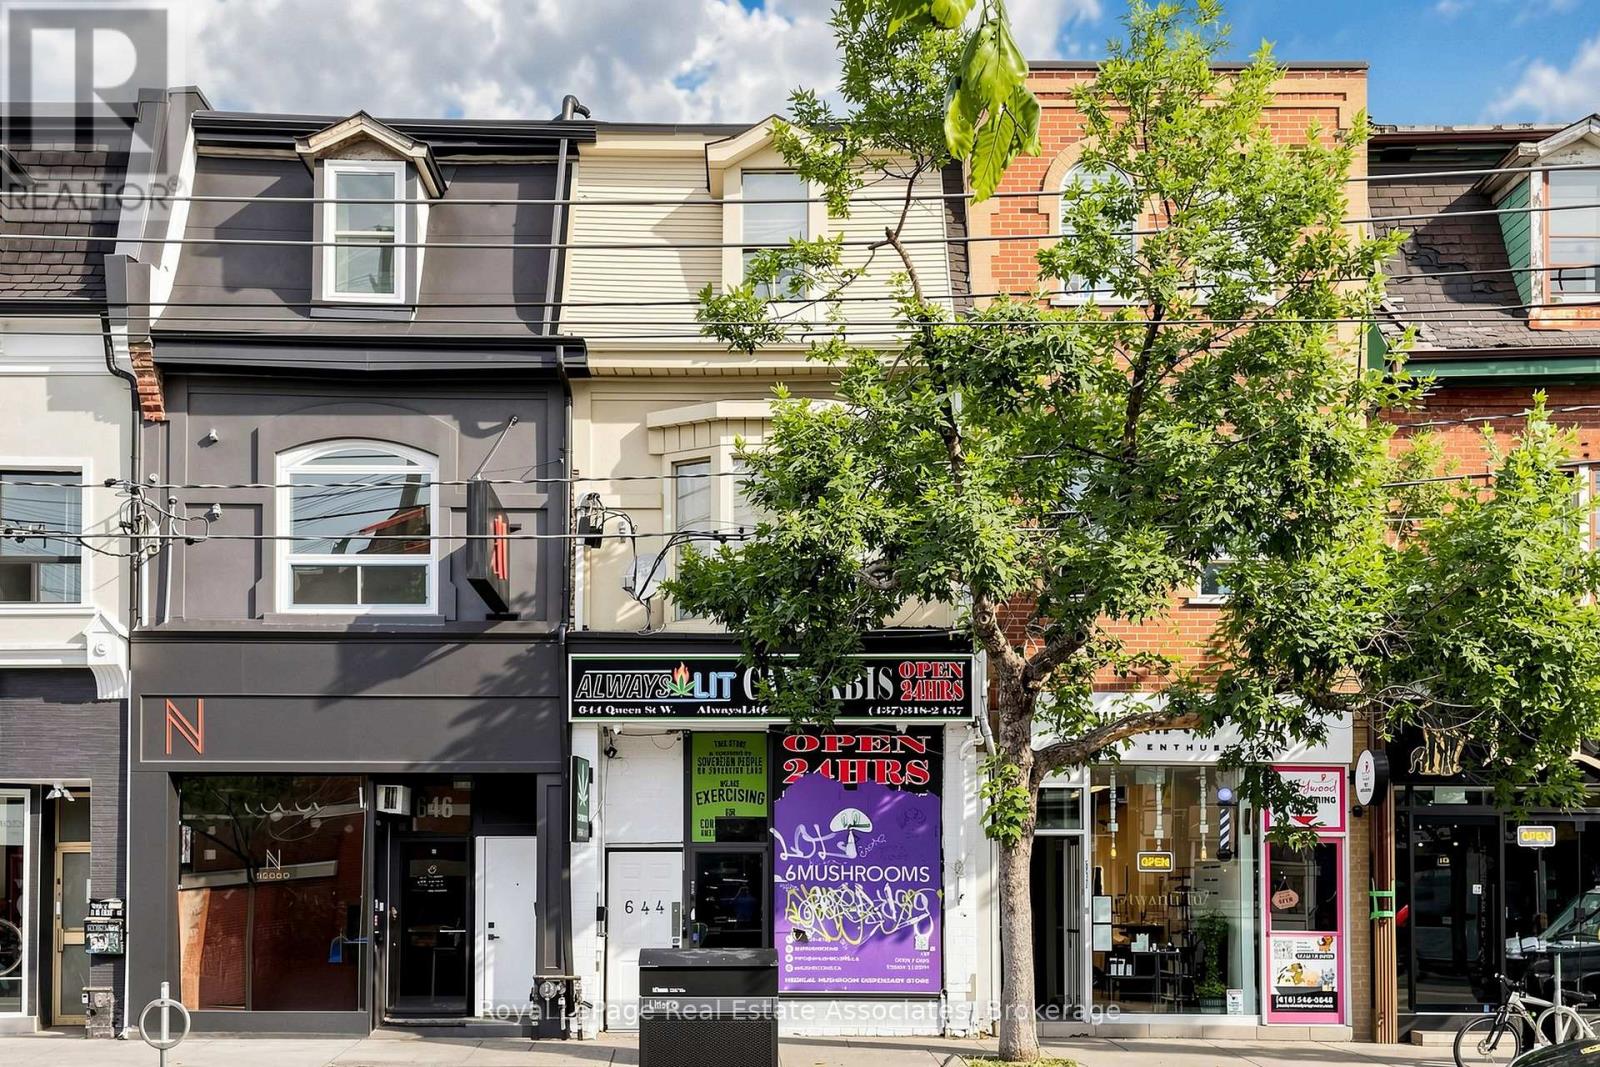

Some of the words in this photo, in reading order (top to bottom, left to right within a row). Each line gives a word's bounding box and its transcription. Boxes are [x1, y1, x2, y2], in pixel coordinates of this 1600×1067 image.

[898, 661, 966, 679] OPEN
[575, 673, 672, 699] ALWAYS
[693, 671, 737, 699] LIT
[900, 679, 965, 701] 24HRS
[605, 705, 642, 715] Queen
[645, 705, 657, 715] St
[660, 705, 676, 715] W.
[165, 698, 205, 755] N
[782, 734, 931, 754] OPEN
[697, 756, 736, 767] SOVEREIGN
[738, 756, 763, 767] PEOPLE
[782, 758, 931, 785] 24HRS
[695, 788, 766, 806] EXERCISING
[416, 796, 453, 818] 646
[1520, 830, 1552, 842] OPEN
[1140, 856, 1170, 867] OPEN
[785, 864, 930, 882] 6MUSHROOMS
[624, 900, 665, 915] 644
